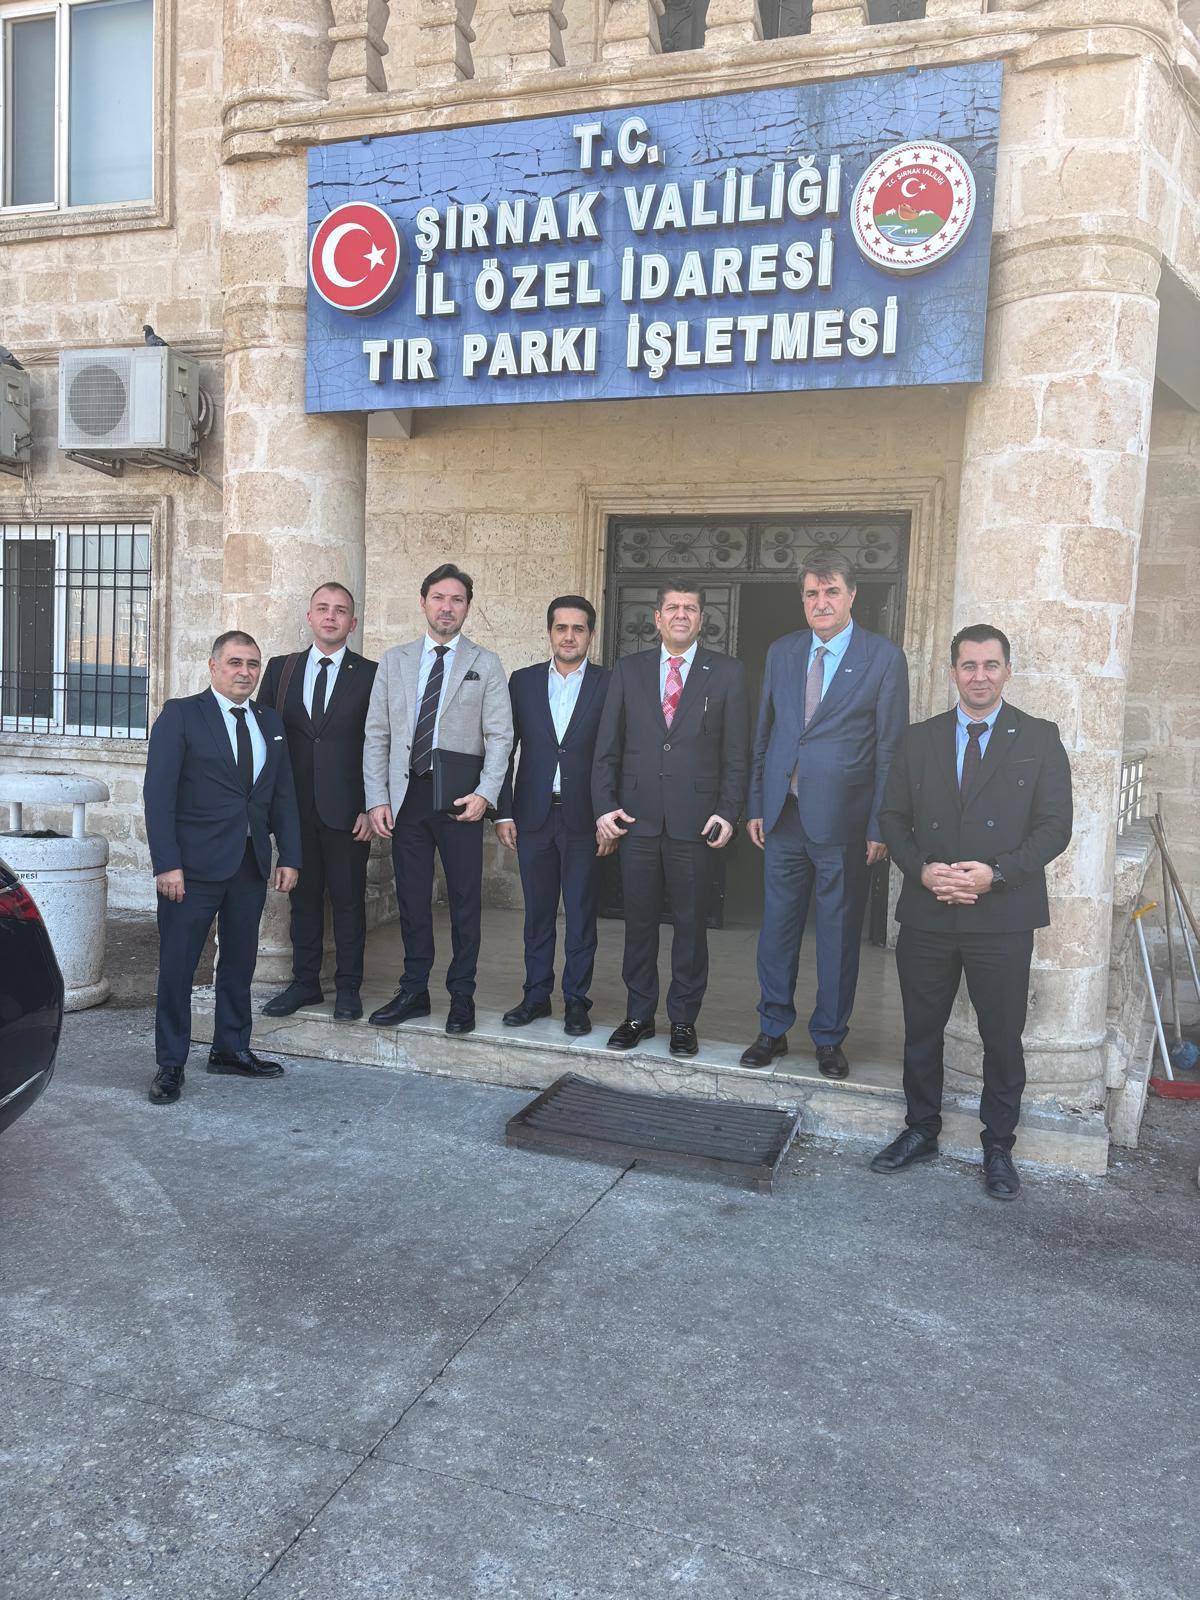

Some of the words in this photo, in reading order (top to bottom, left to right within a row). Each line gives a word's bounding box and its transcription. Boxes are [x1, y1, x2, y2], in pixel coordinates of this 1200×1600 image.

[573, 116, 660, 169] T.C.
[415, 191, 601, 261] ŞIRNAK
[624, 154, 841, 231] VALİLİĞİ
[415, 264, 455, 315] İL
[475, 258, 601, 312] ÖZEL
[621, 228, 833, 301] İDARESİ
[363, 337, 434, 381] TIR
[463, 327, 597, 377] PARKI
[626, 296, 898, 379] İŞLETMESİ
